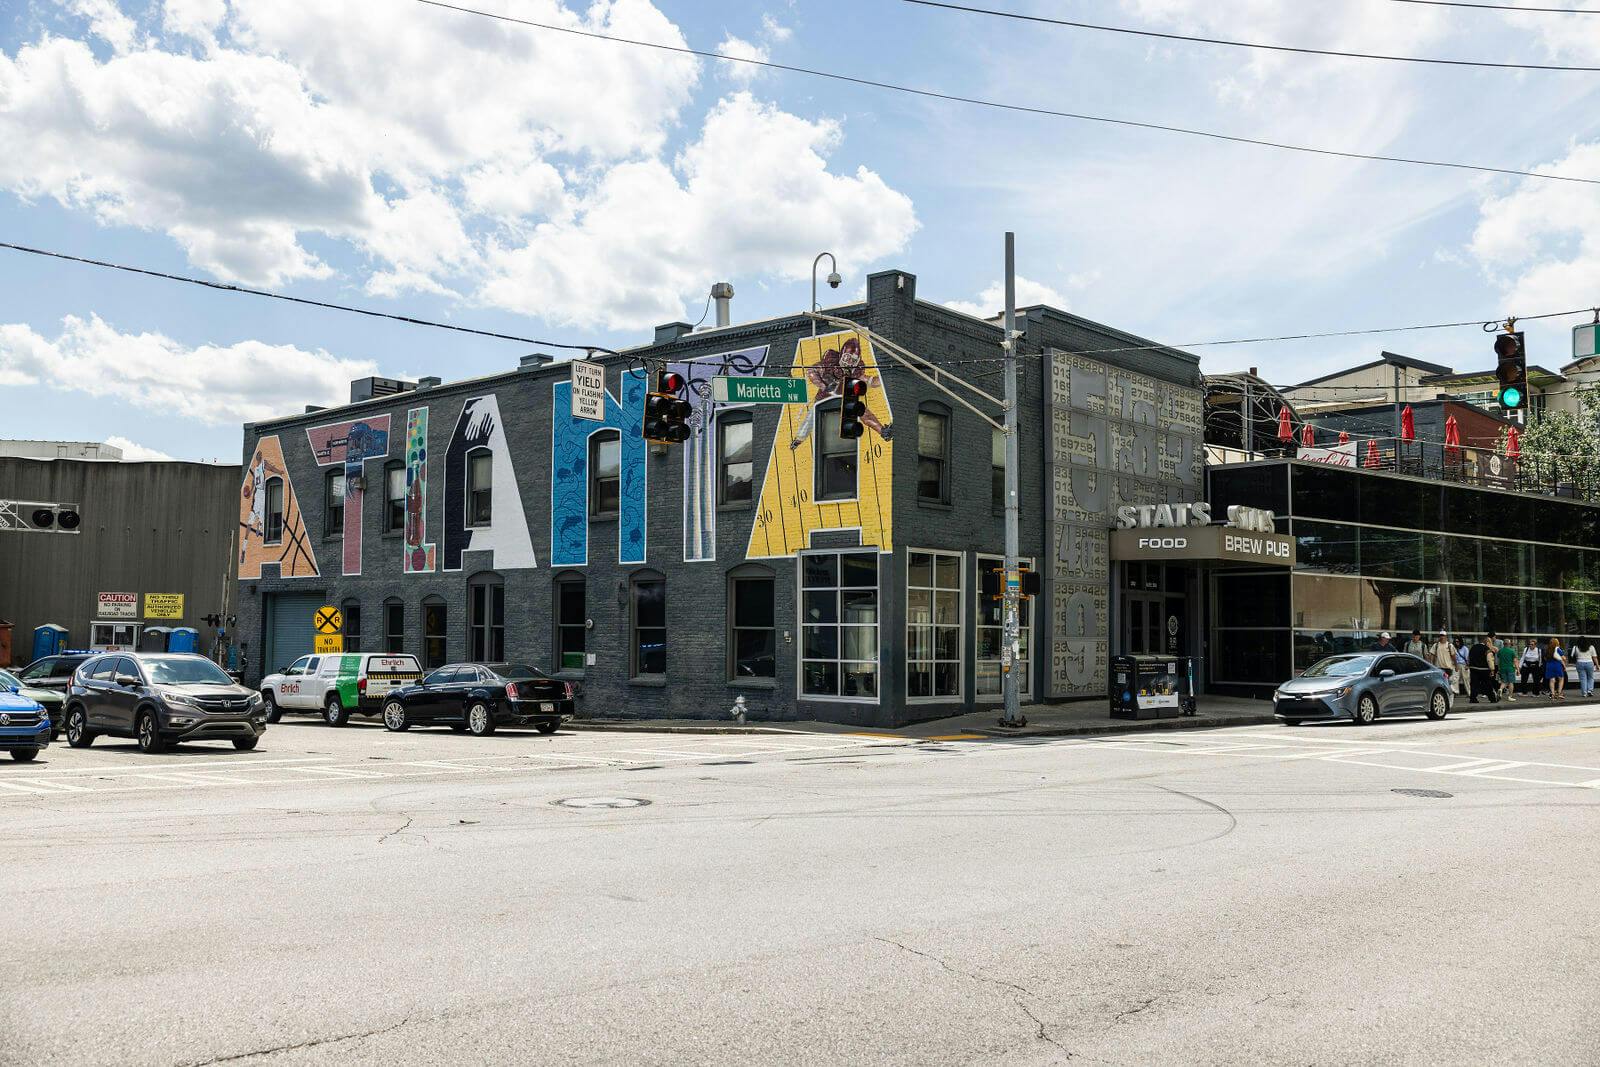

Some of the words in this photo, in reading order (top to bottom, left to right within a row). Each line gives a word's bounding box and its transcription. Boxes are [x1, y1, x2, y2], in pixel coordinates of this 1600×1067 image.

[575, 365, 587, 373] LEFT
[589, 367, 602, 377] TURN
[577, 375, 600, 389] YIELD
[788, 380, 797, 388] ST
[737, 383, 781, 398] Marietta
[580, 398, 598, 407] YELLOW
[580, 406, 597, 416] ARROW
[1116, 501, 1212, 529] STATS
[1139, 538, 1187, 549] FOOD
[1225, 534, 1263, 554] BREW
[1266, 540, 1290, 558] PUB
[280, 683, 300, 693] Ehrlich
